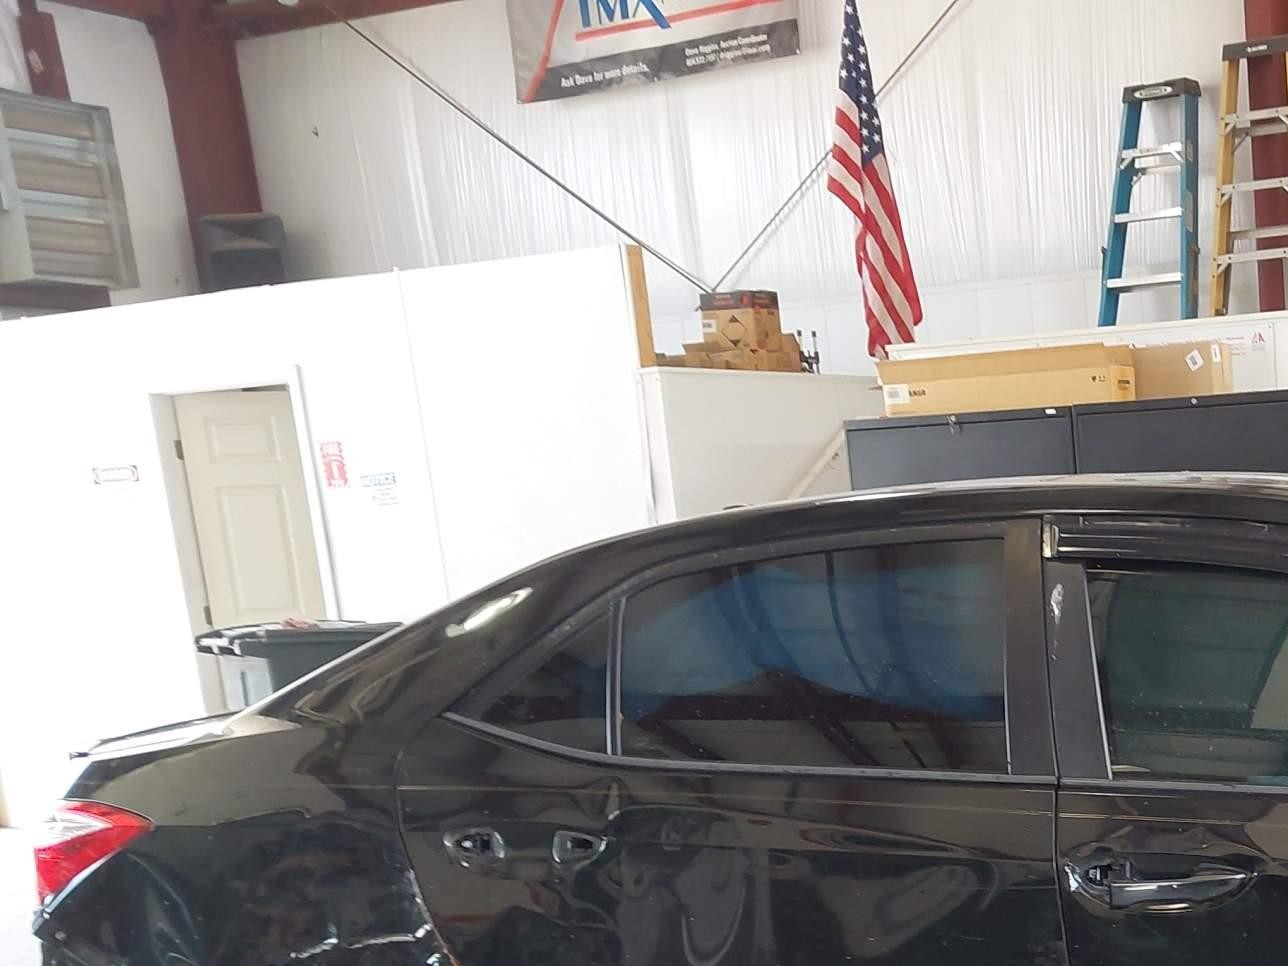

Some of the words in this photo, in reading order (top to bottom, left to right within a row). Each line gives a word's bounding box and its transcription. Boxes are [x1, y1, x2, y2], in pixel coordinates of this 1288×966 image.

[561, 77, 574, 87] Ask
[574, 74, 593, 85] Dave
[594, 71, 603, 81] for
[604, 68, 621, 79] more
